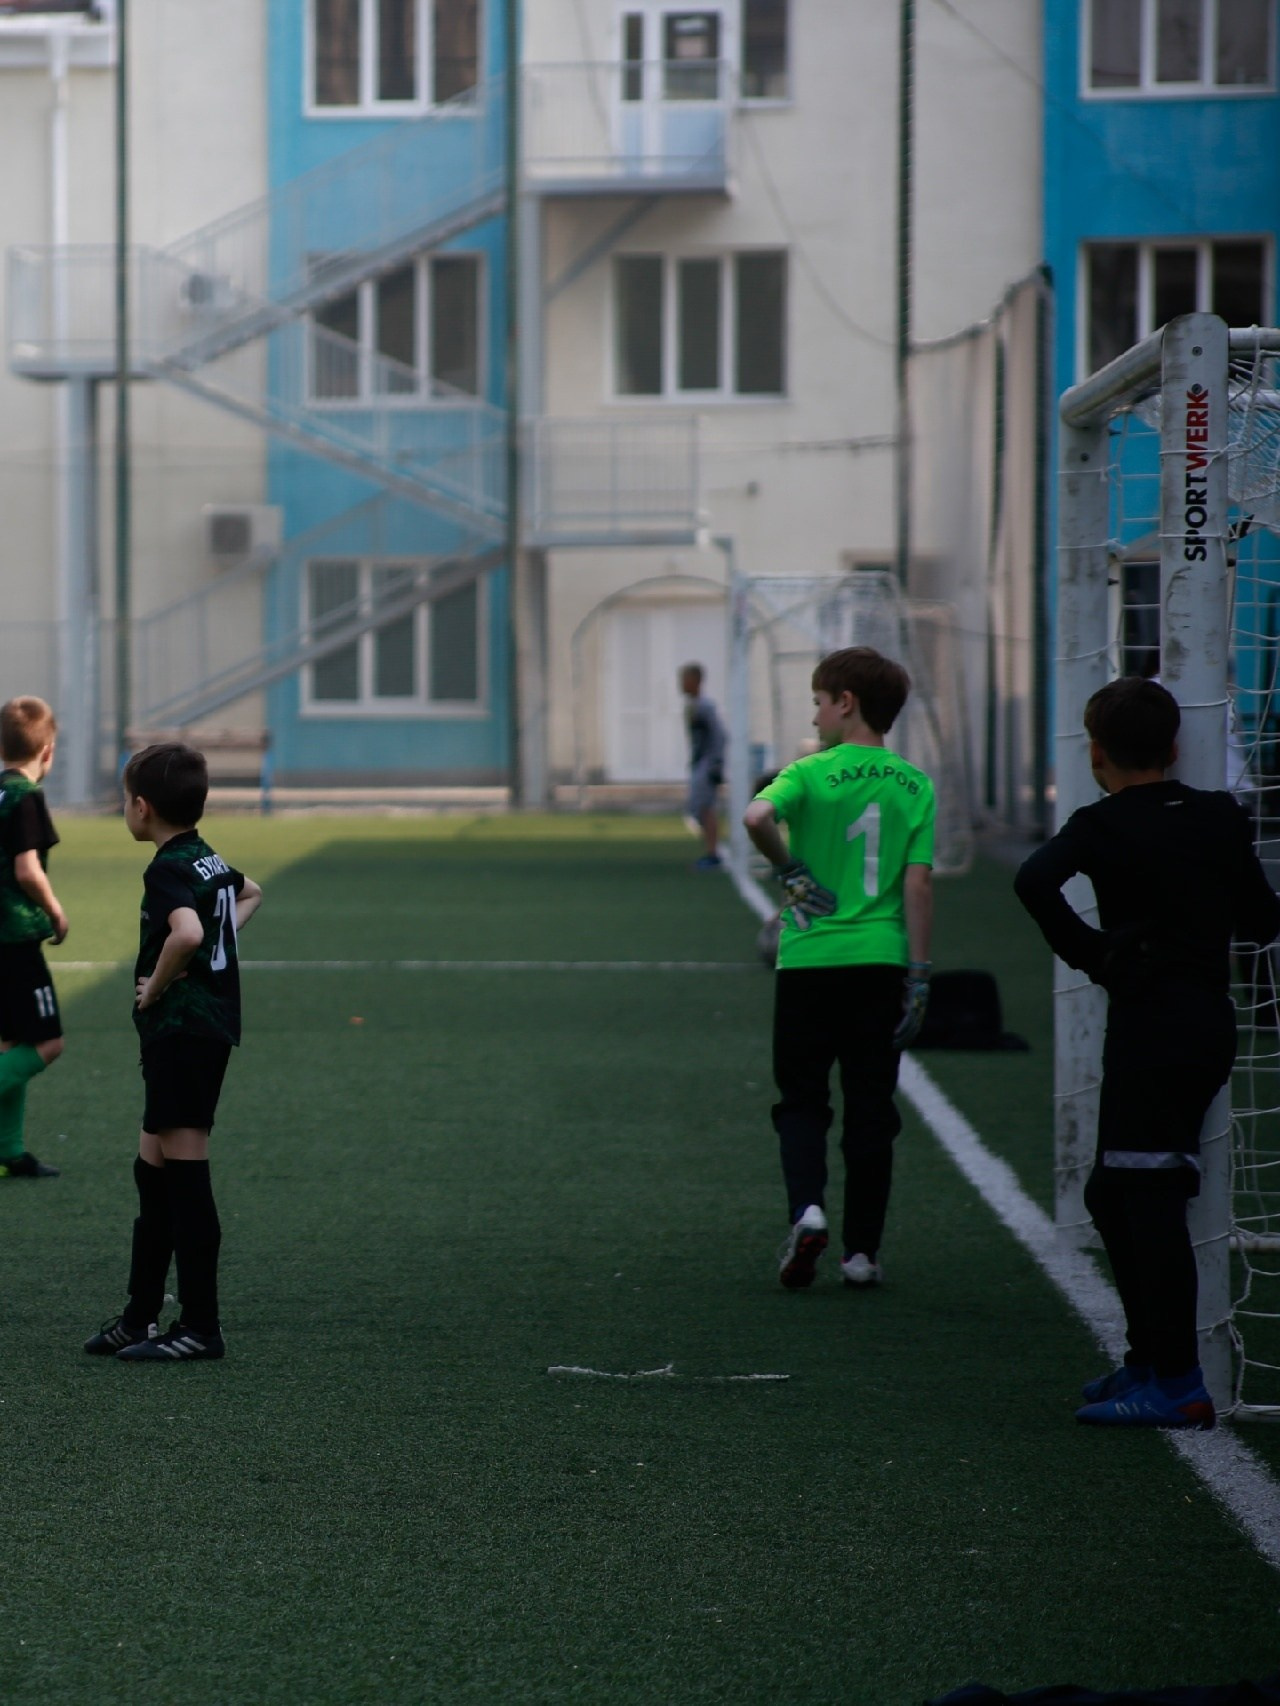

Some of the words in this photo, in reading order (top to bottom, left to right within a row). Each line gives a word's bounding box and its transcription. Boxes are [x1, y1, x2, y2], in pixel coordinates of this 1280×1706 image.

[1184, 389, 1209, 562] SPORTWERK
[826, 764, 920, 796] ЗАХАРОВ
[846, 802, 881, 897] 1
[34, 985, 55, 1017] 11
